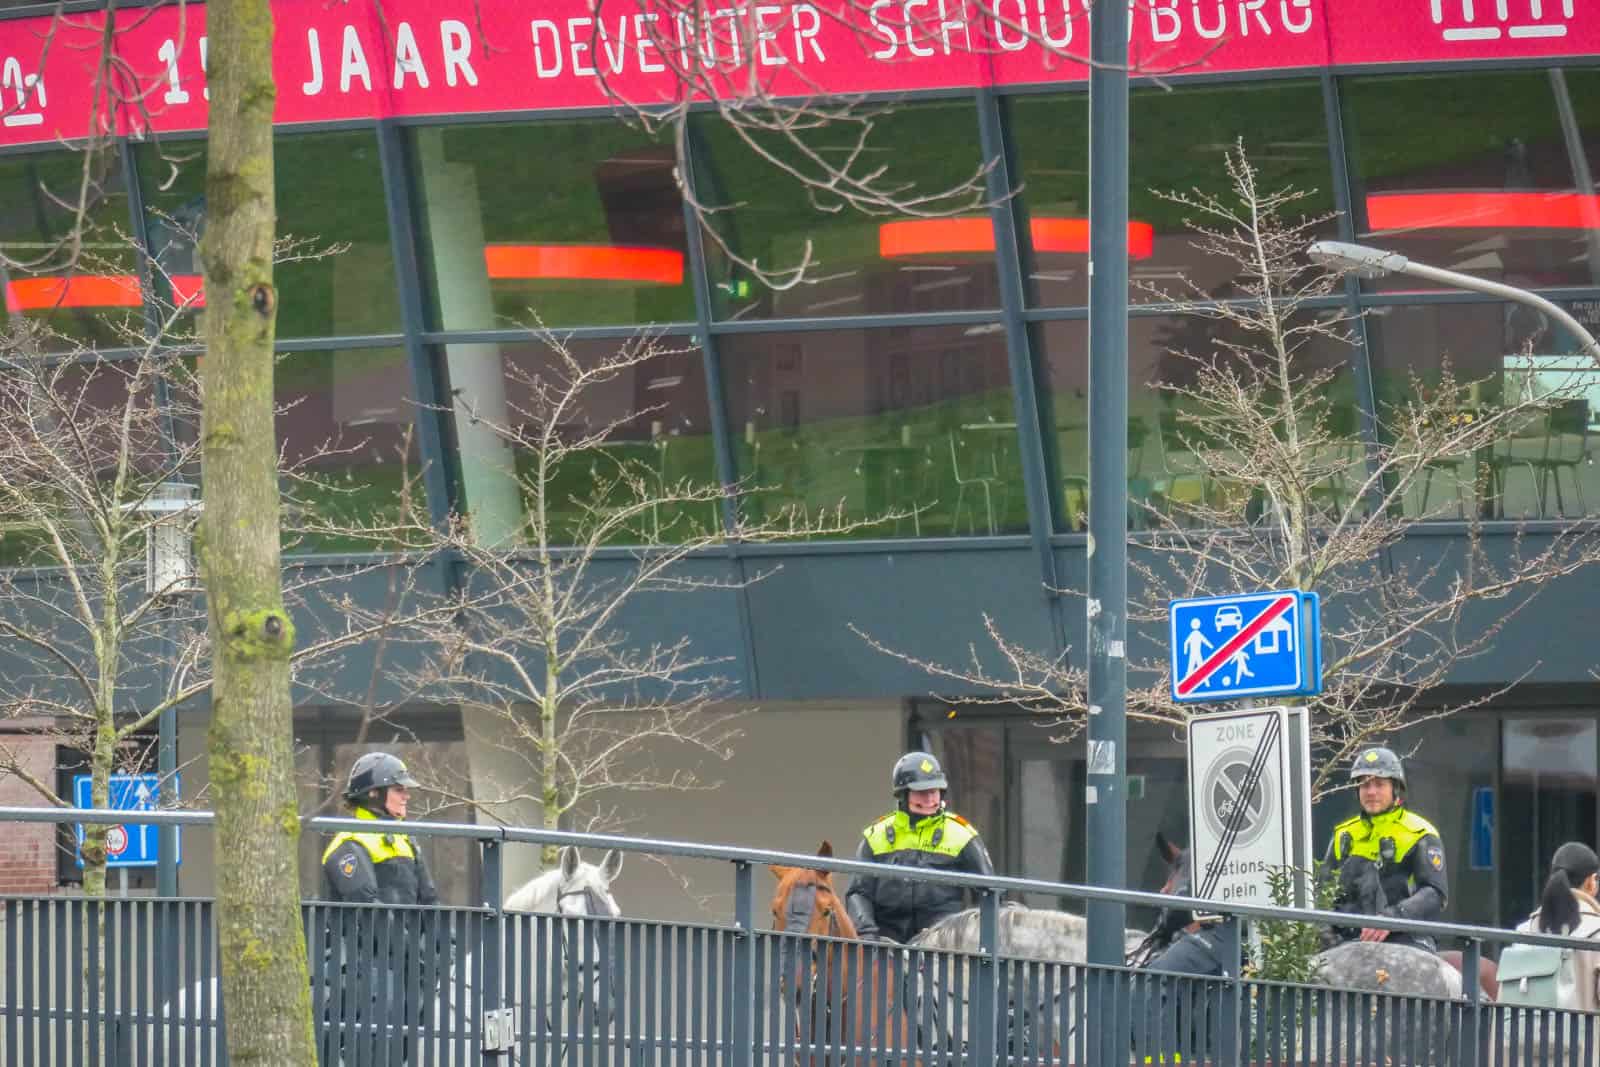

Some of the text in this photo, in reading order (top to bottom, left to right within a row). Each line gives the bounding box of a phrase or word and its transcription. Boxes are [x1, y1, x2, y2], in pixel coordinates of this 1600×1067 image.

[302, 21, 478, 96] JAAR
[530, 4, 826, 78] DEVENTER
[870, 0, 1313, 59] SCHOUBURG
[1216, 723, 1255, 742] ZONE
[1223, 882, 1257, 902] plein
